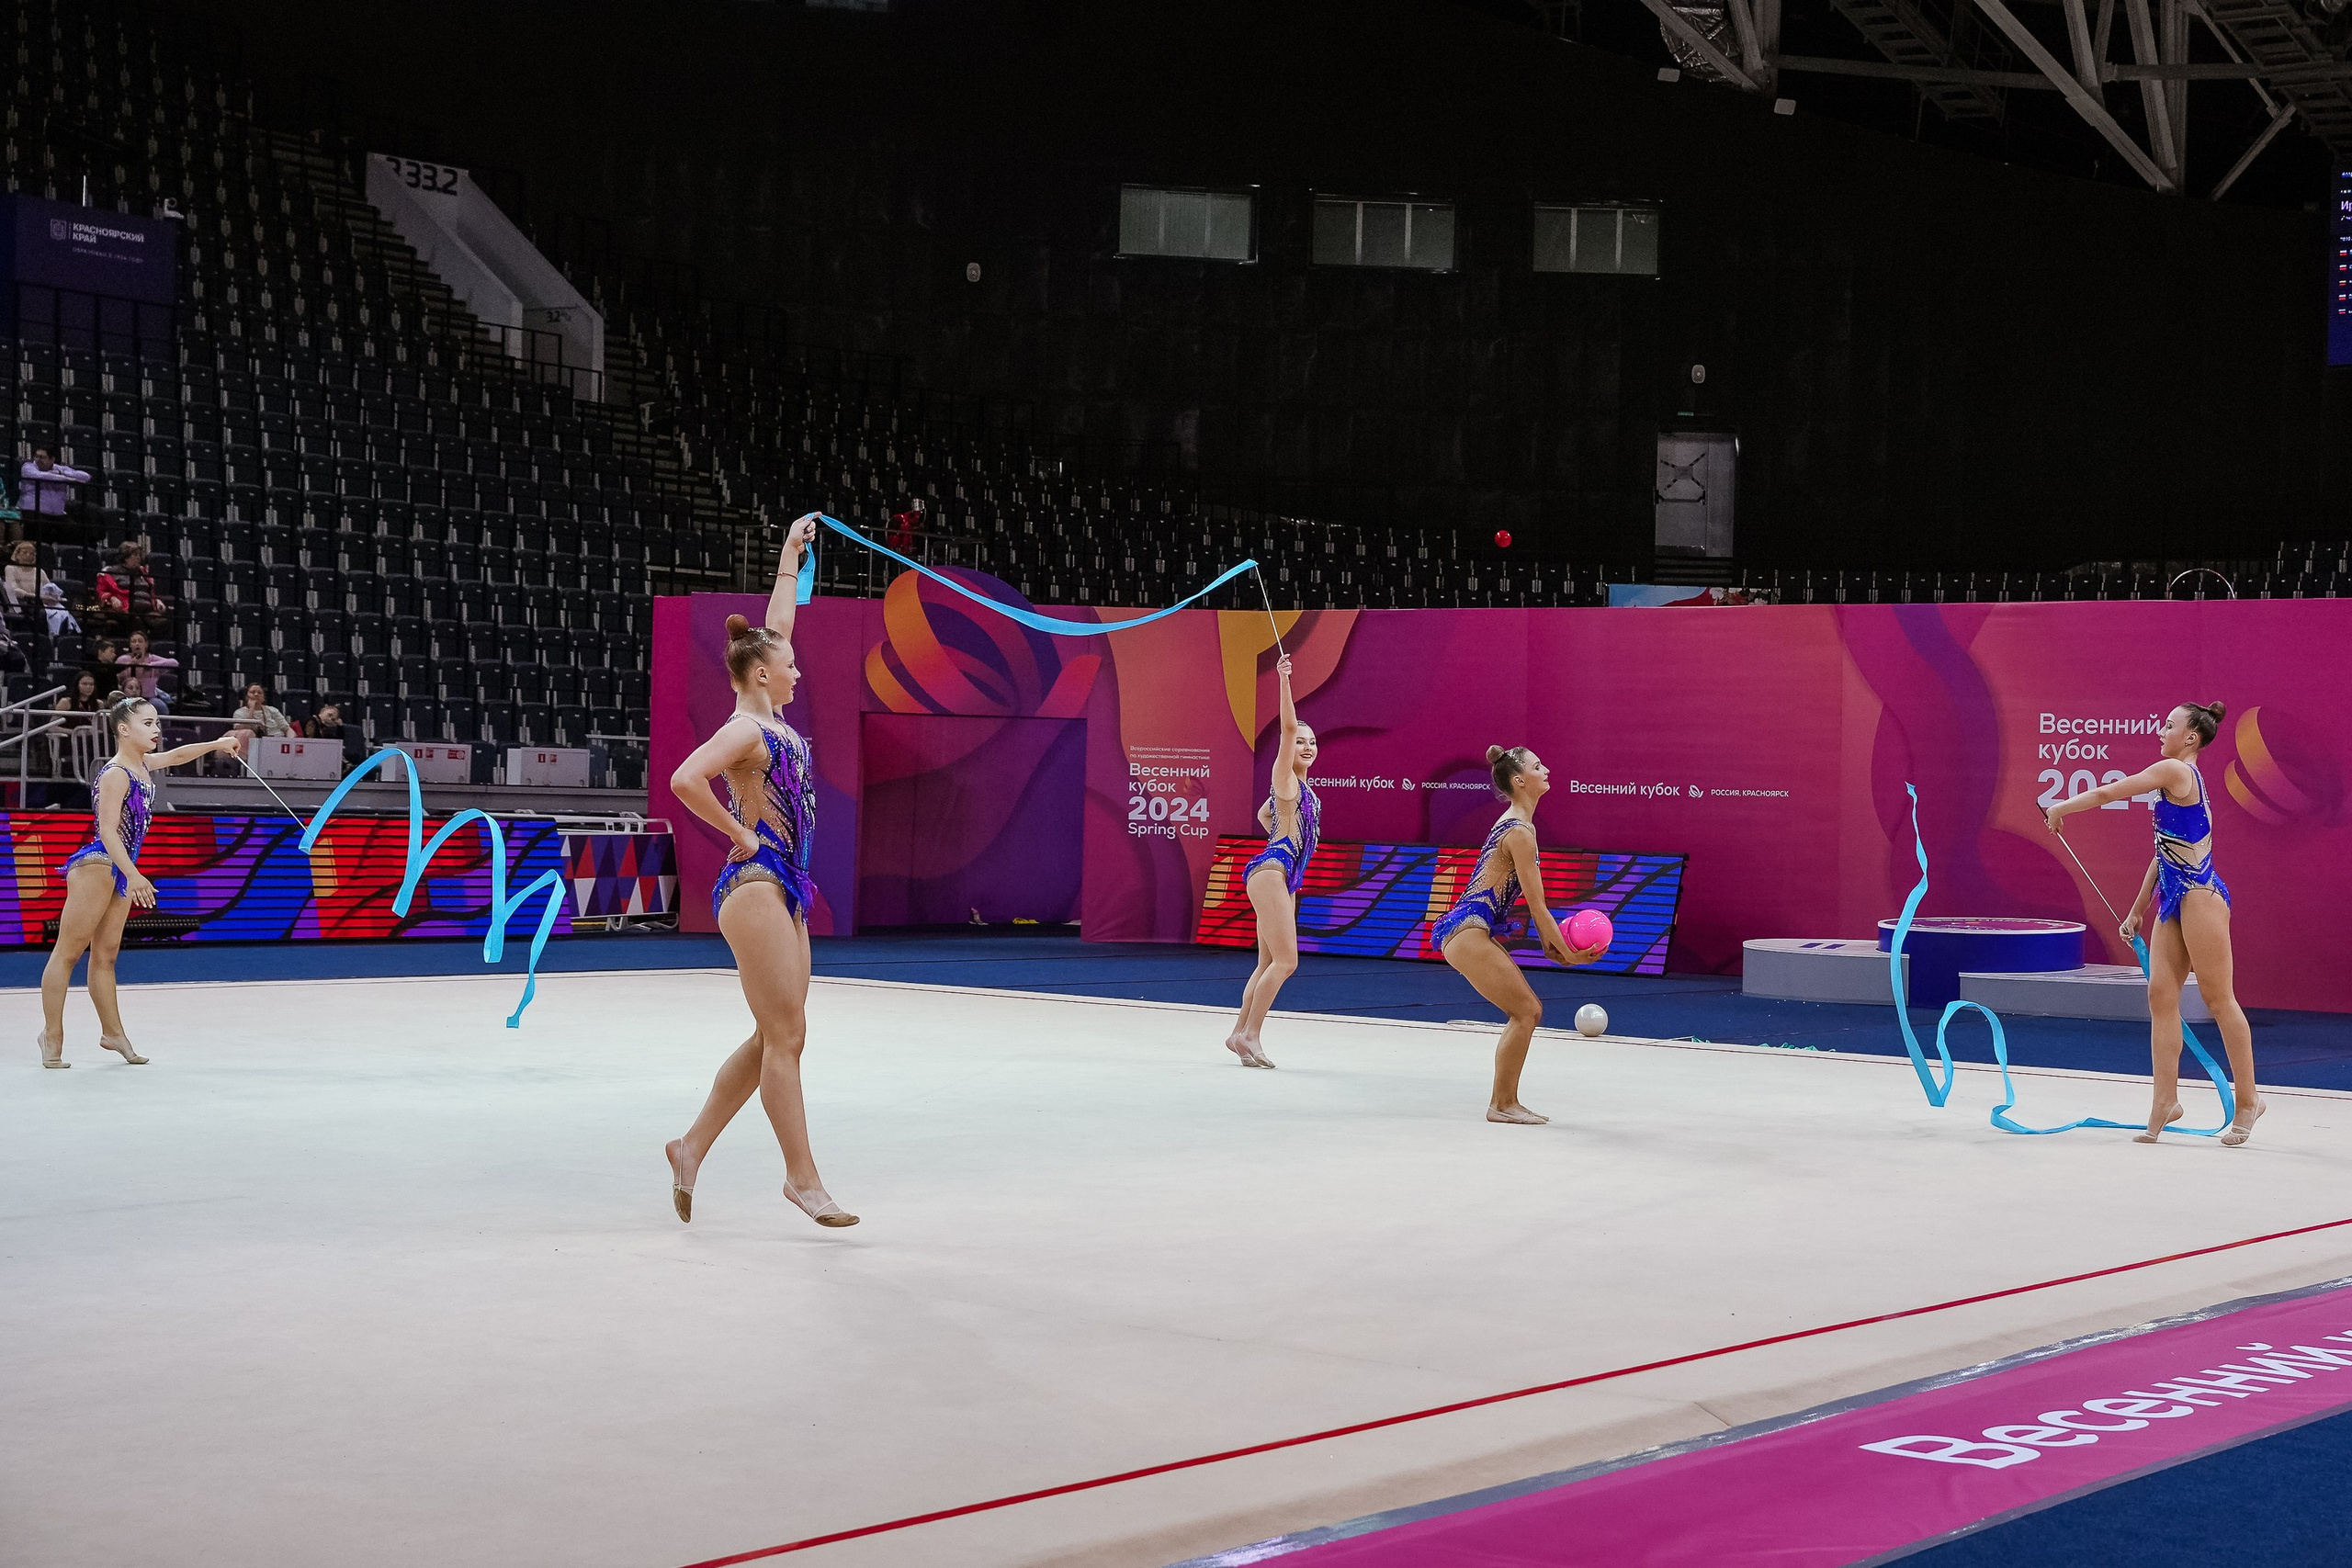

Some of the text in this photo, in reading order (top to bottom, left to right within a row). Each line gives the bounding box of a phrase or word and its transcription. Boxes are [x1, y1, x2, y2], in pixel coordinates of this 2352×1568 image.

[73, 223, 145, 243] КРАСНОЯРСКИЙ
[73, 232, 96, 243] КРАЙ
[2039, 713, 2161, 734] Весенний
[2038, 738, 2109, 765] кубок
[1129, 762, 1210, 778] Весенний
[1129, 779, 1176, 795] кубок
[1306, 776, 1357, 788] есенний
[1359, 775, 1396, 792] кубок
[1569, 779, 1790, 798] Весенний кубок РОССИЯ, КРАСНОЯРСК
[1128, 796, 1210, 822] 2024
[1128, 822, 1209, 839] Spring Cup
[1857, 1342, 2352, 1470] Весенний
